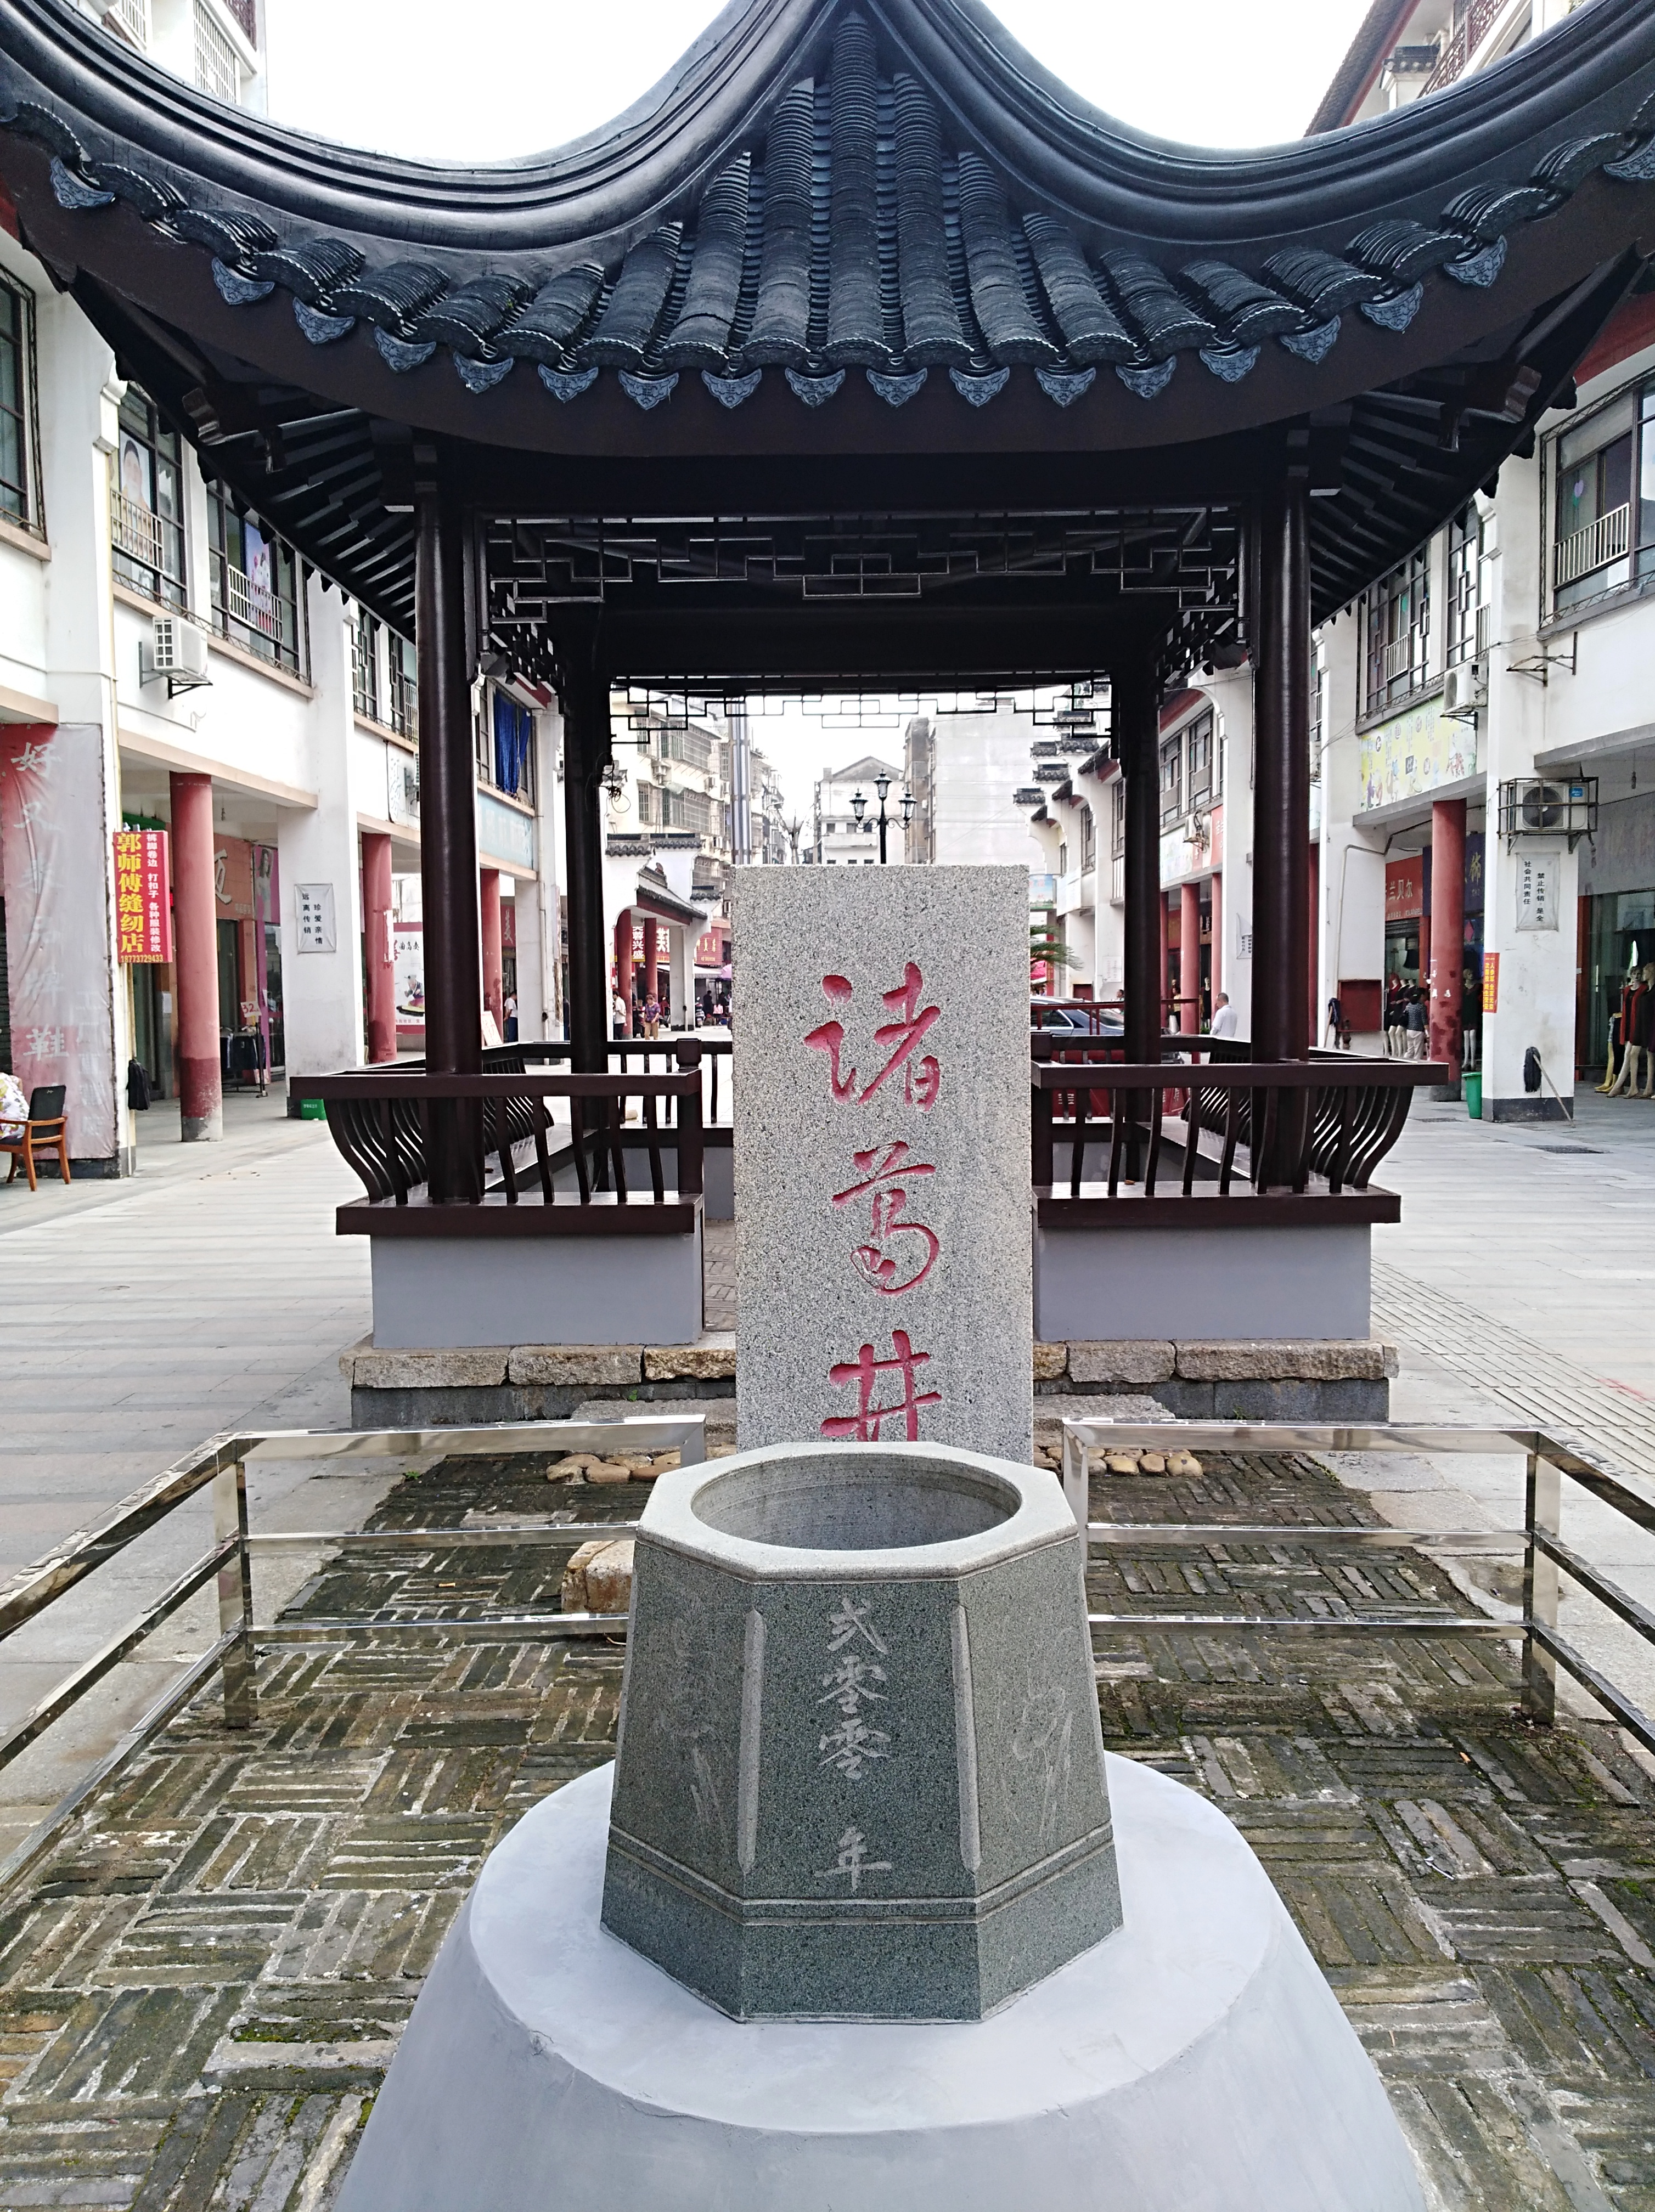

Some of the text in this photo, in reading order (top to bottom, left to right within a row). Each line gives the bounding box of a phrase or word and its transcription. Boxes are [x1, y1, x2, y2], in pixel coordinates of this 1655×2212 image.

[116, 833, 144, 953] 郭师傅缝纫店
[147, 833, 161, 952] 裤脚卷边 打扣子 各种服装修改
[1386, 878, 1413, 901] 兰贝尔
[1523, 861, 1532, 905] 社会共同责任
[302, 893, 312, 934] 远离传销
[314, 904, 323, 945] 珍爱亲情
[121, 954, 164, 963] 18773729433
[803, 961, 942, 1442] 诸葛井
